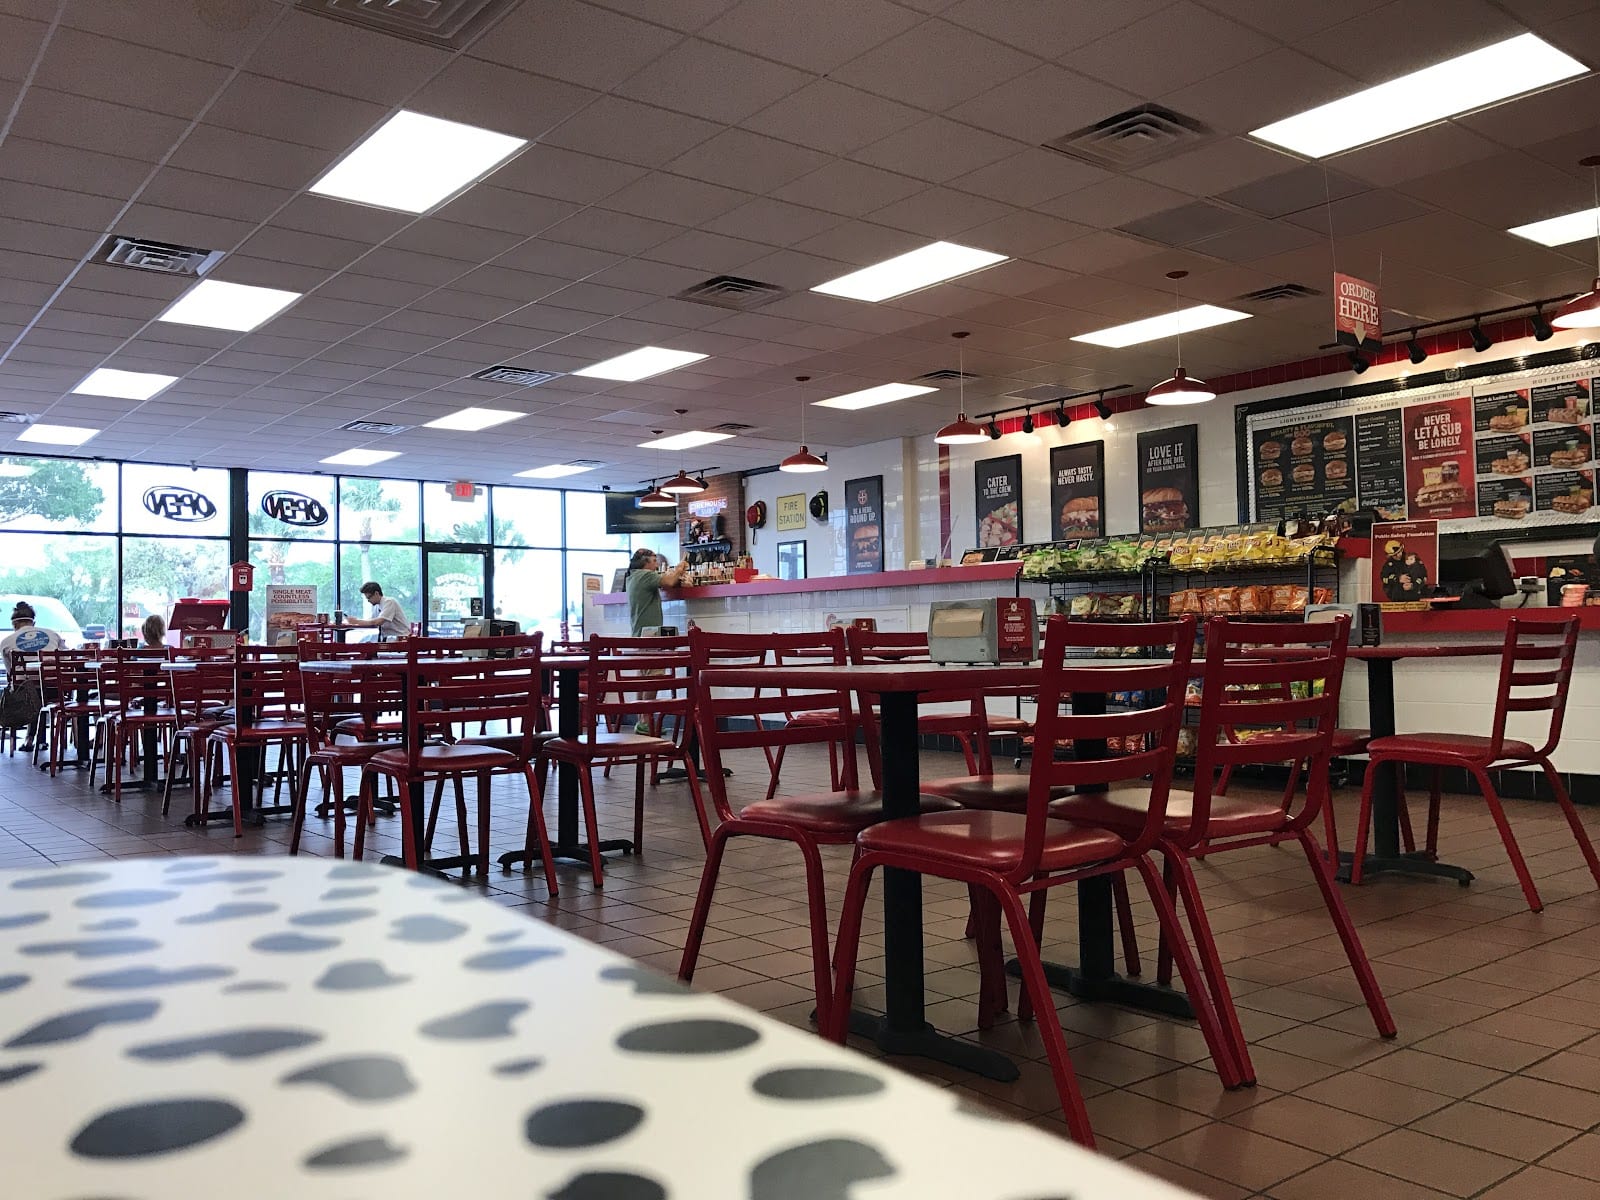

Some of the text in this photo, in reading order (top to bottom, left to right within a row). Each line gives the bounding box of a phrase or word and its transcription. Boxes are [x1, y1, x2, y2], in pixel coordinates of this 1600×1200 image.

[1340, 282, 1376, 305] ORDER
[1339, 296, 1379, 326] HERE
[1551, 371, 1594, 382] SPECIALTY
[1424, 413, 1451, 426] NEVER
[1414, 426, 1432, 440] LET
[1432, 425, 1440, 438] A
[1440, 422, 1462, 437] SUB
[1418, 440, 1429, 450] BE
[1149, 443, 1183, 460] LOVE IT
[1147, 459, 1162, 467] AFTER
[1162, 457, 1173, 465] ONE
[1058, 467, 1077, 478] ALWAYS
[988, 475, 1008, 489] CATER
[1057, 475, 1075, 486] NEVER
[983, 488, 989, 496] TO
[999, 485, 1011, 494] CREW
[784, 501, 798, 511] FIRE
[779, 513, 805, 525] STATION
